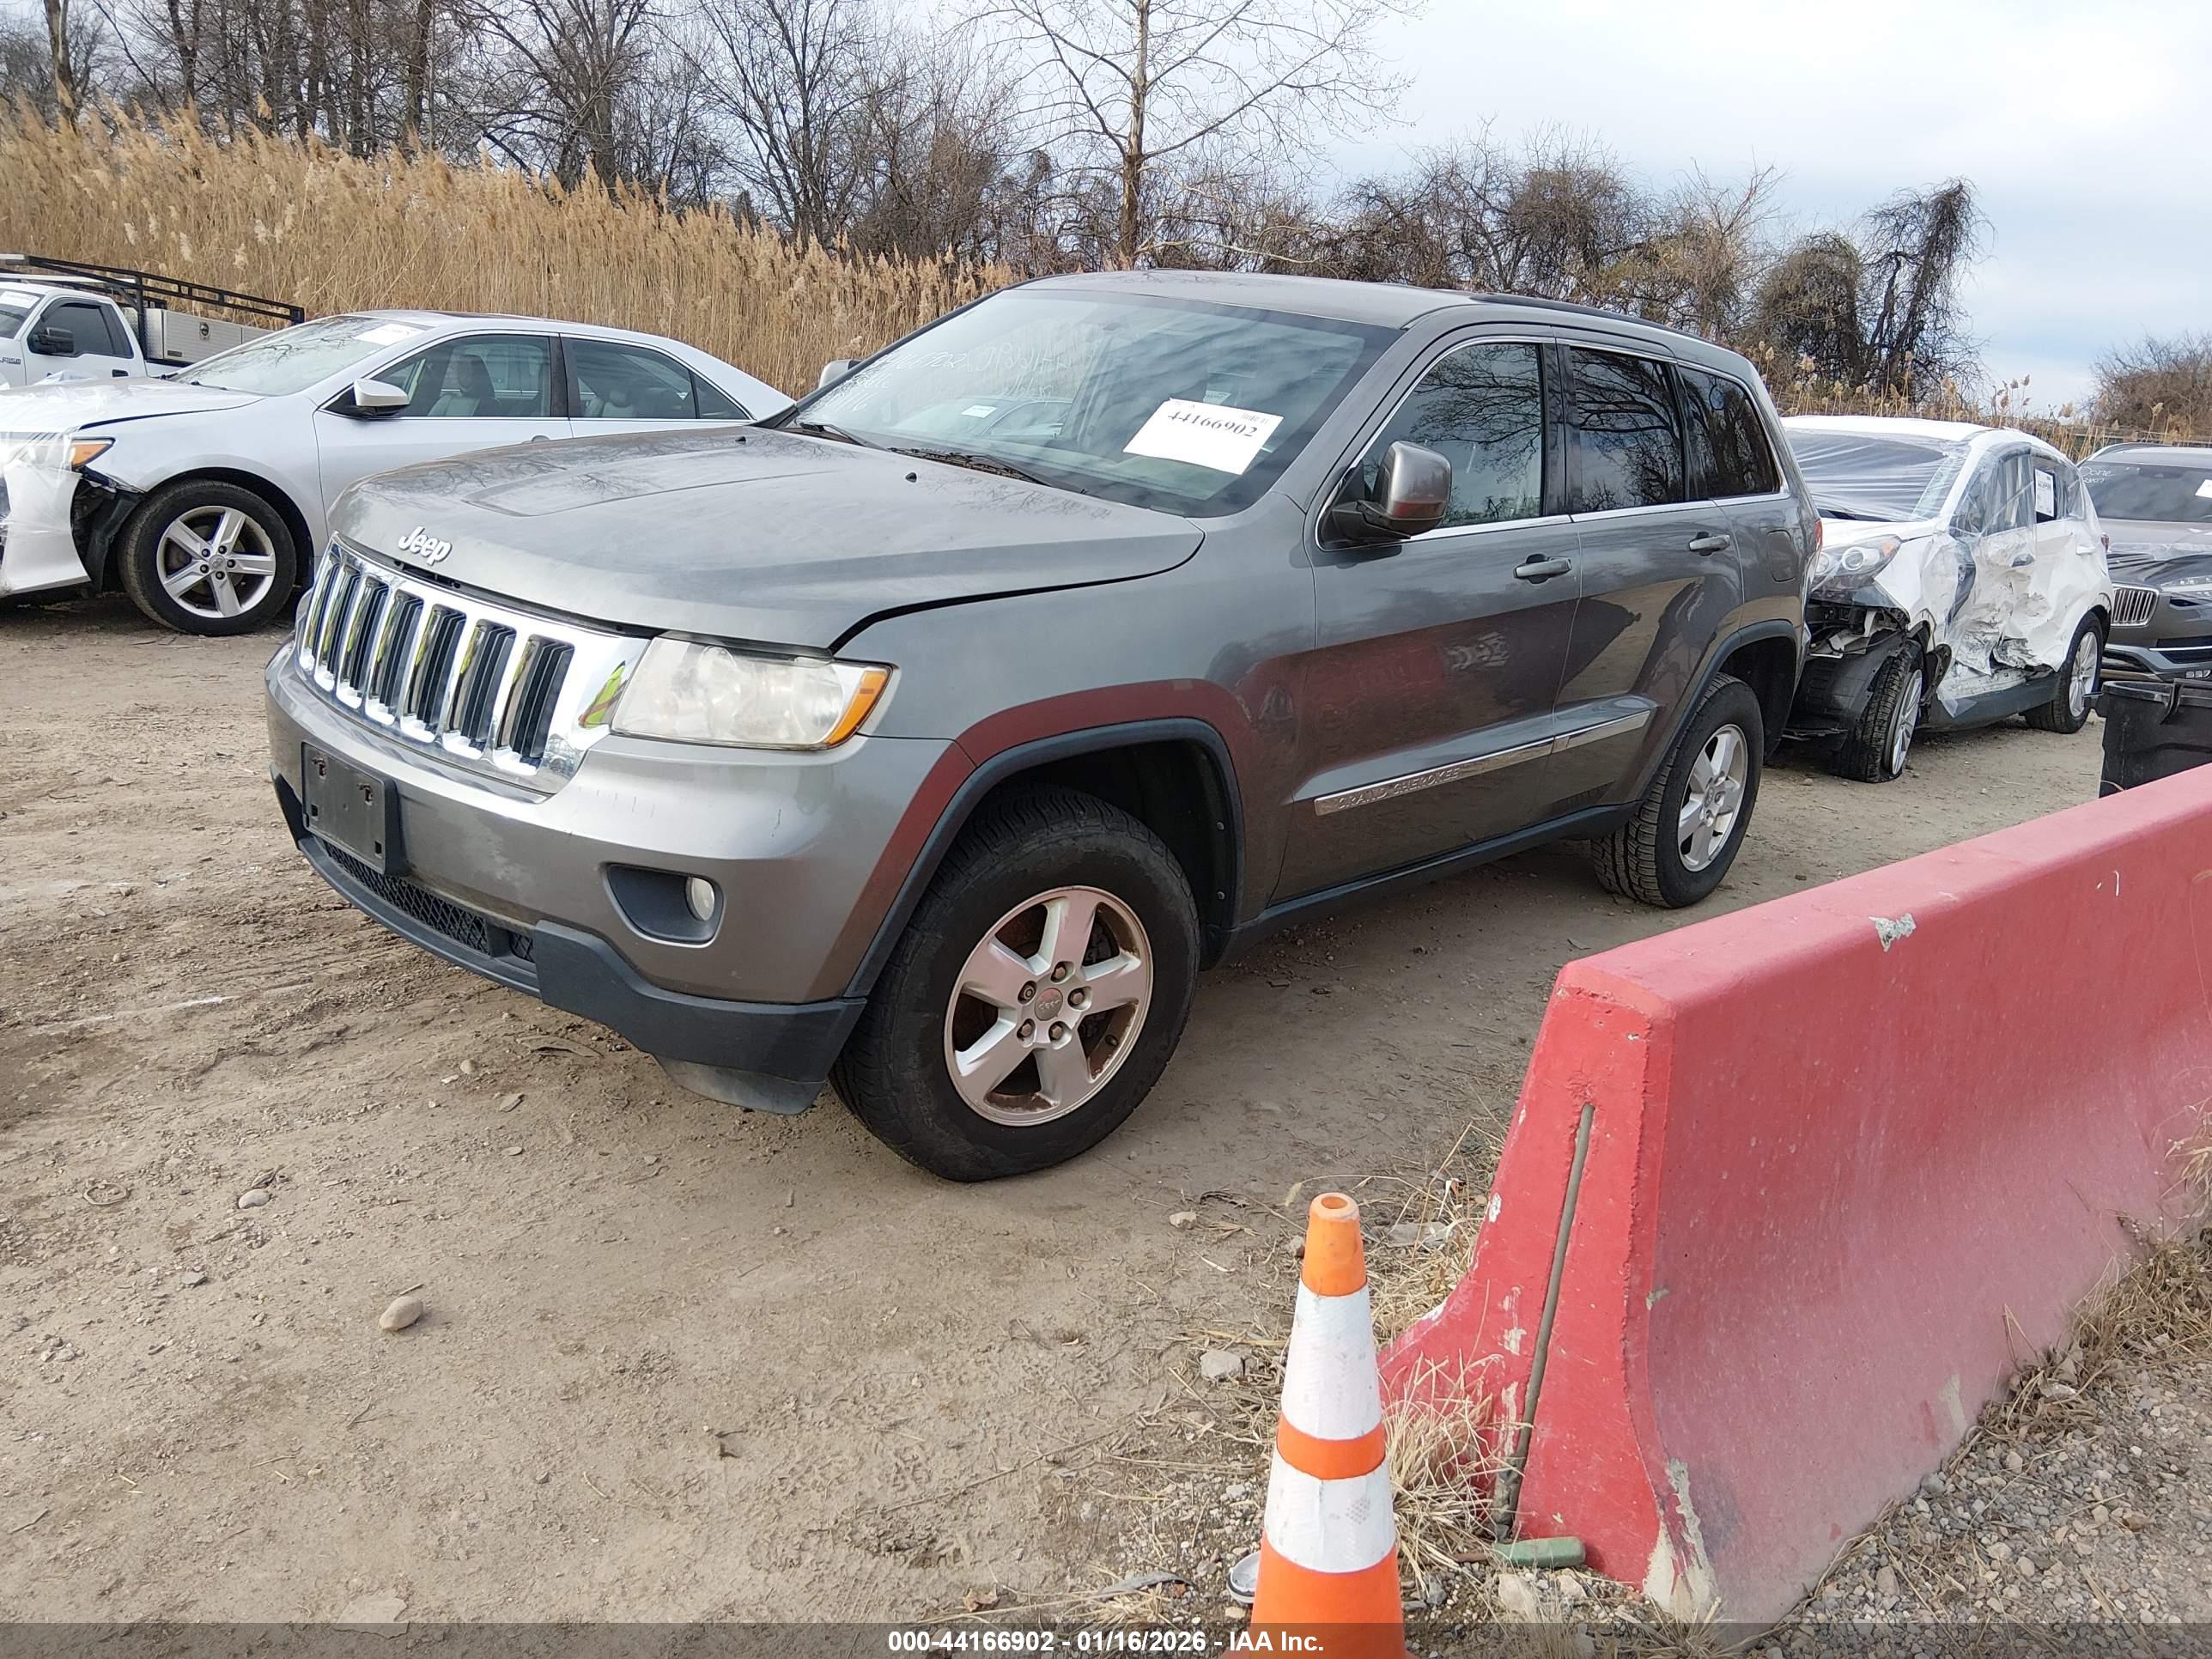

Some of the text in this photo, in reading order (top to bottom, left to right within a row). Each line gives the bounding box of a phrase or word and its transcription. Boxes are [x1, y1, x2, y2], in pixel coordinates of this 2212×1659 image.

[1167, 411, 1258, 437] 44166902
[398, 525, 453, 567] Jeep
[1338, 767, 1461, 810] GRAND CHEROKEE
